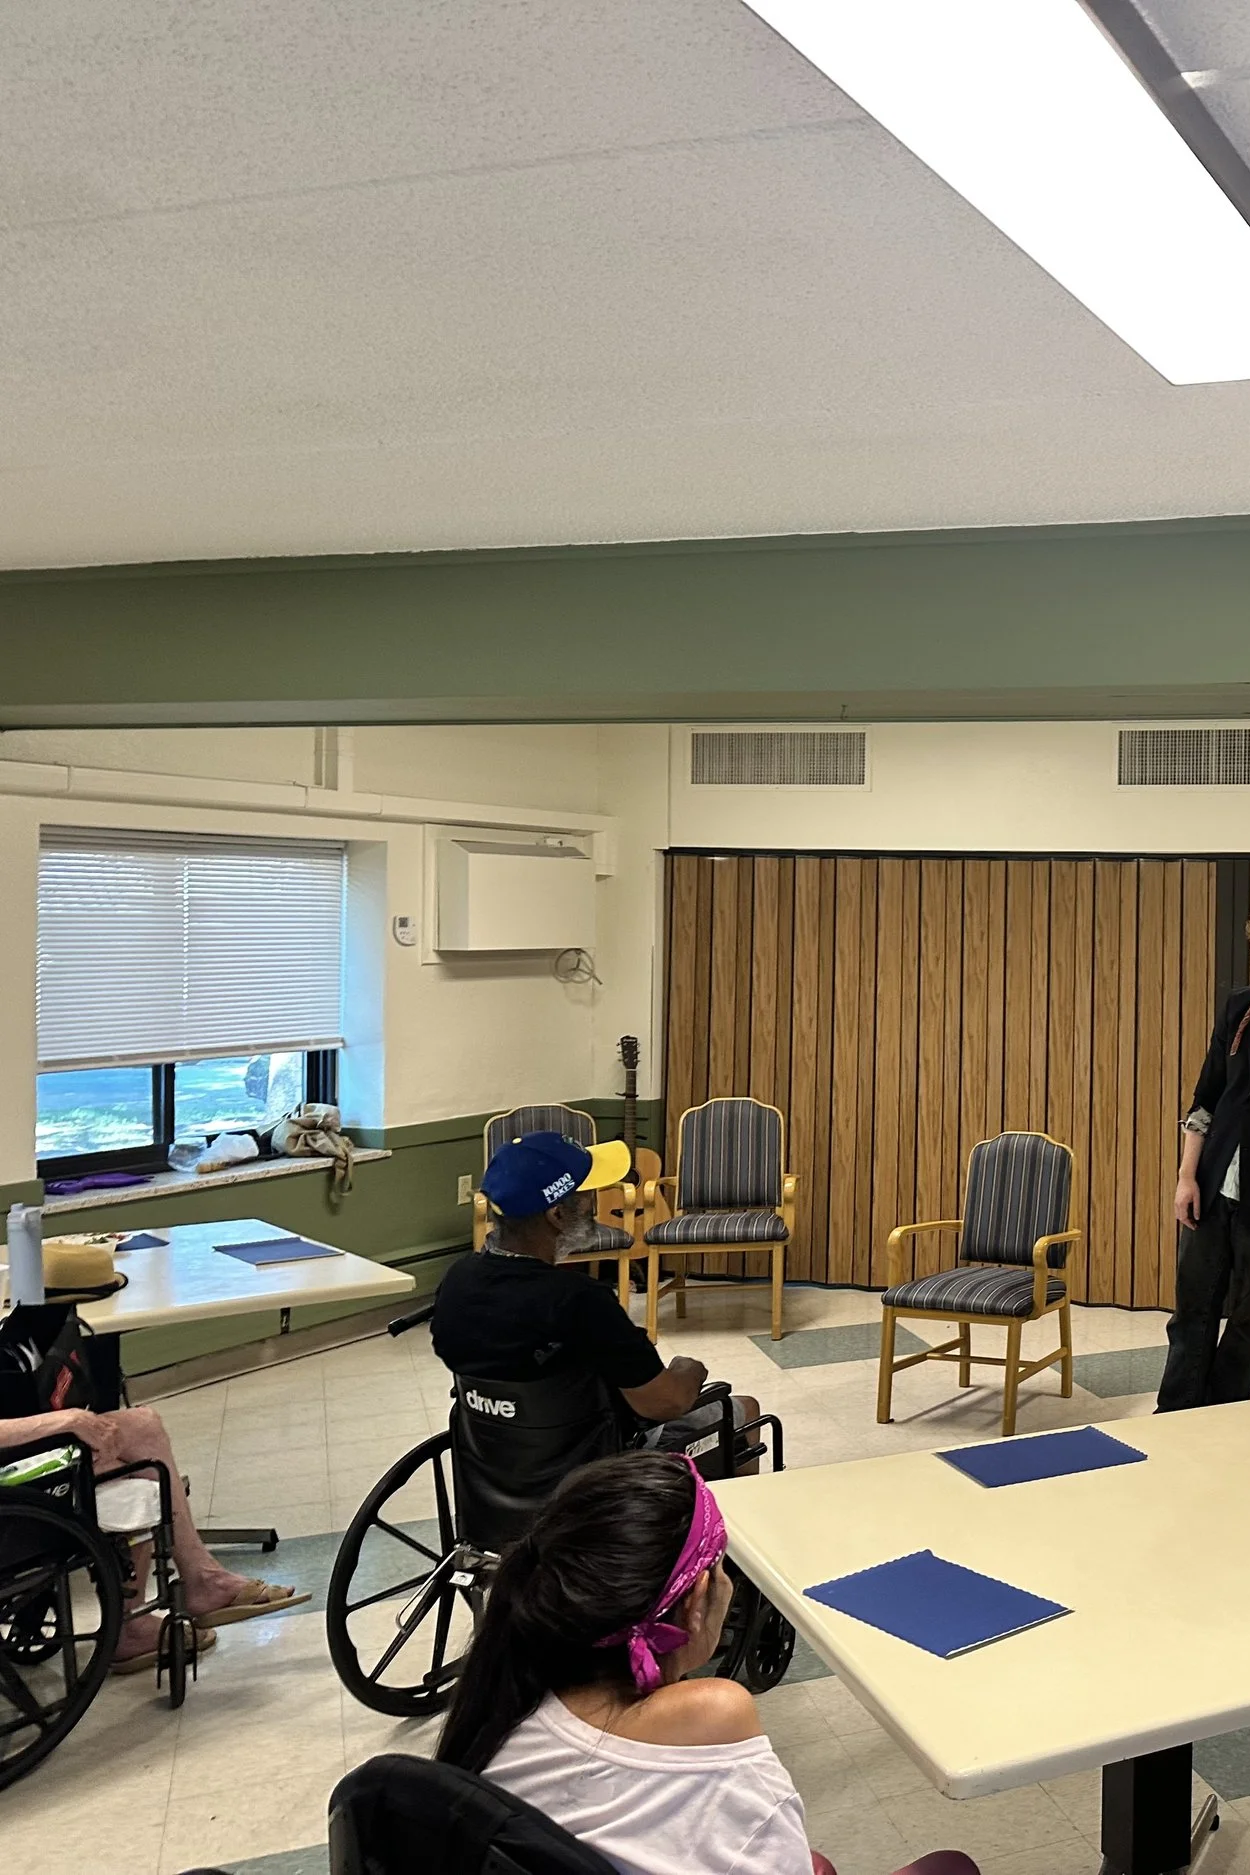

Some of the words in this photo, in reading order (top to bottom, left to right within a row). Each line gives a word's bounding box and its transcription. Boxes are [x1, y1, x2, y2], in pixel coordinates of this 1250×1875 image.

[541, 1172, 572, 1197] 10000
[546, 1179, 575, 1204] LAKES
[465, 1389, 516, 1418] drive
